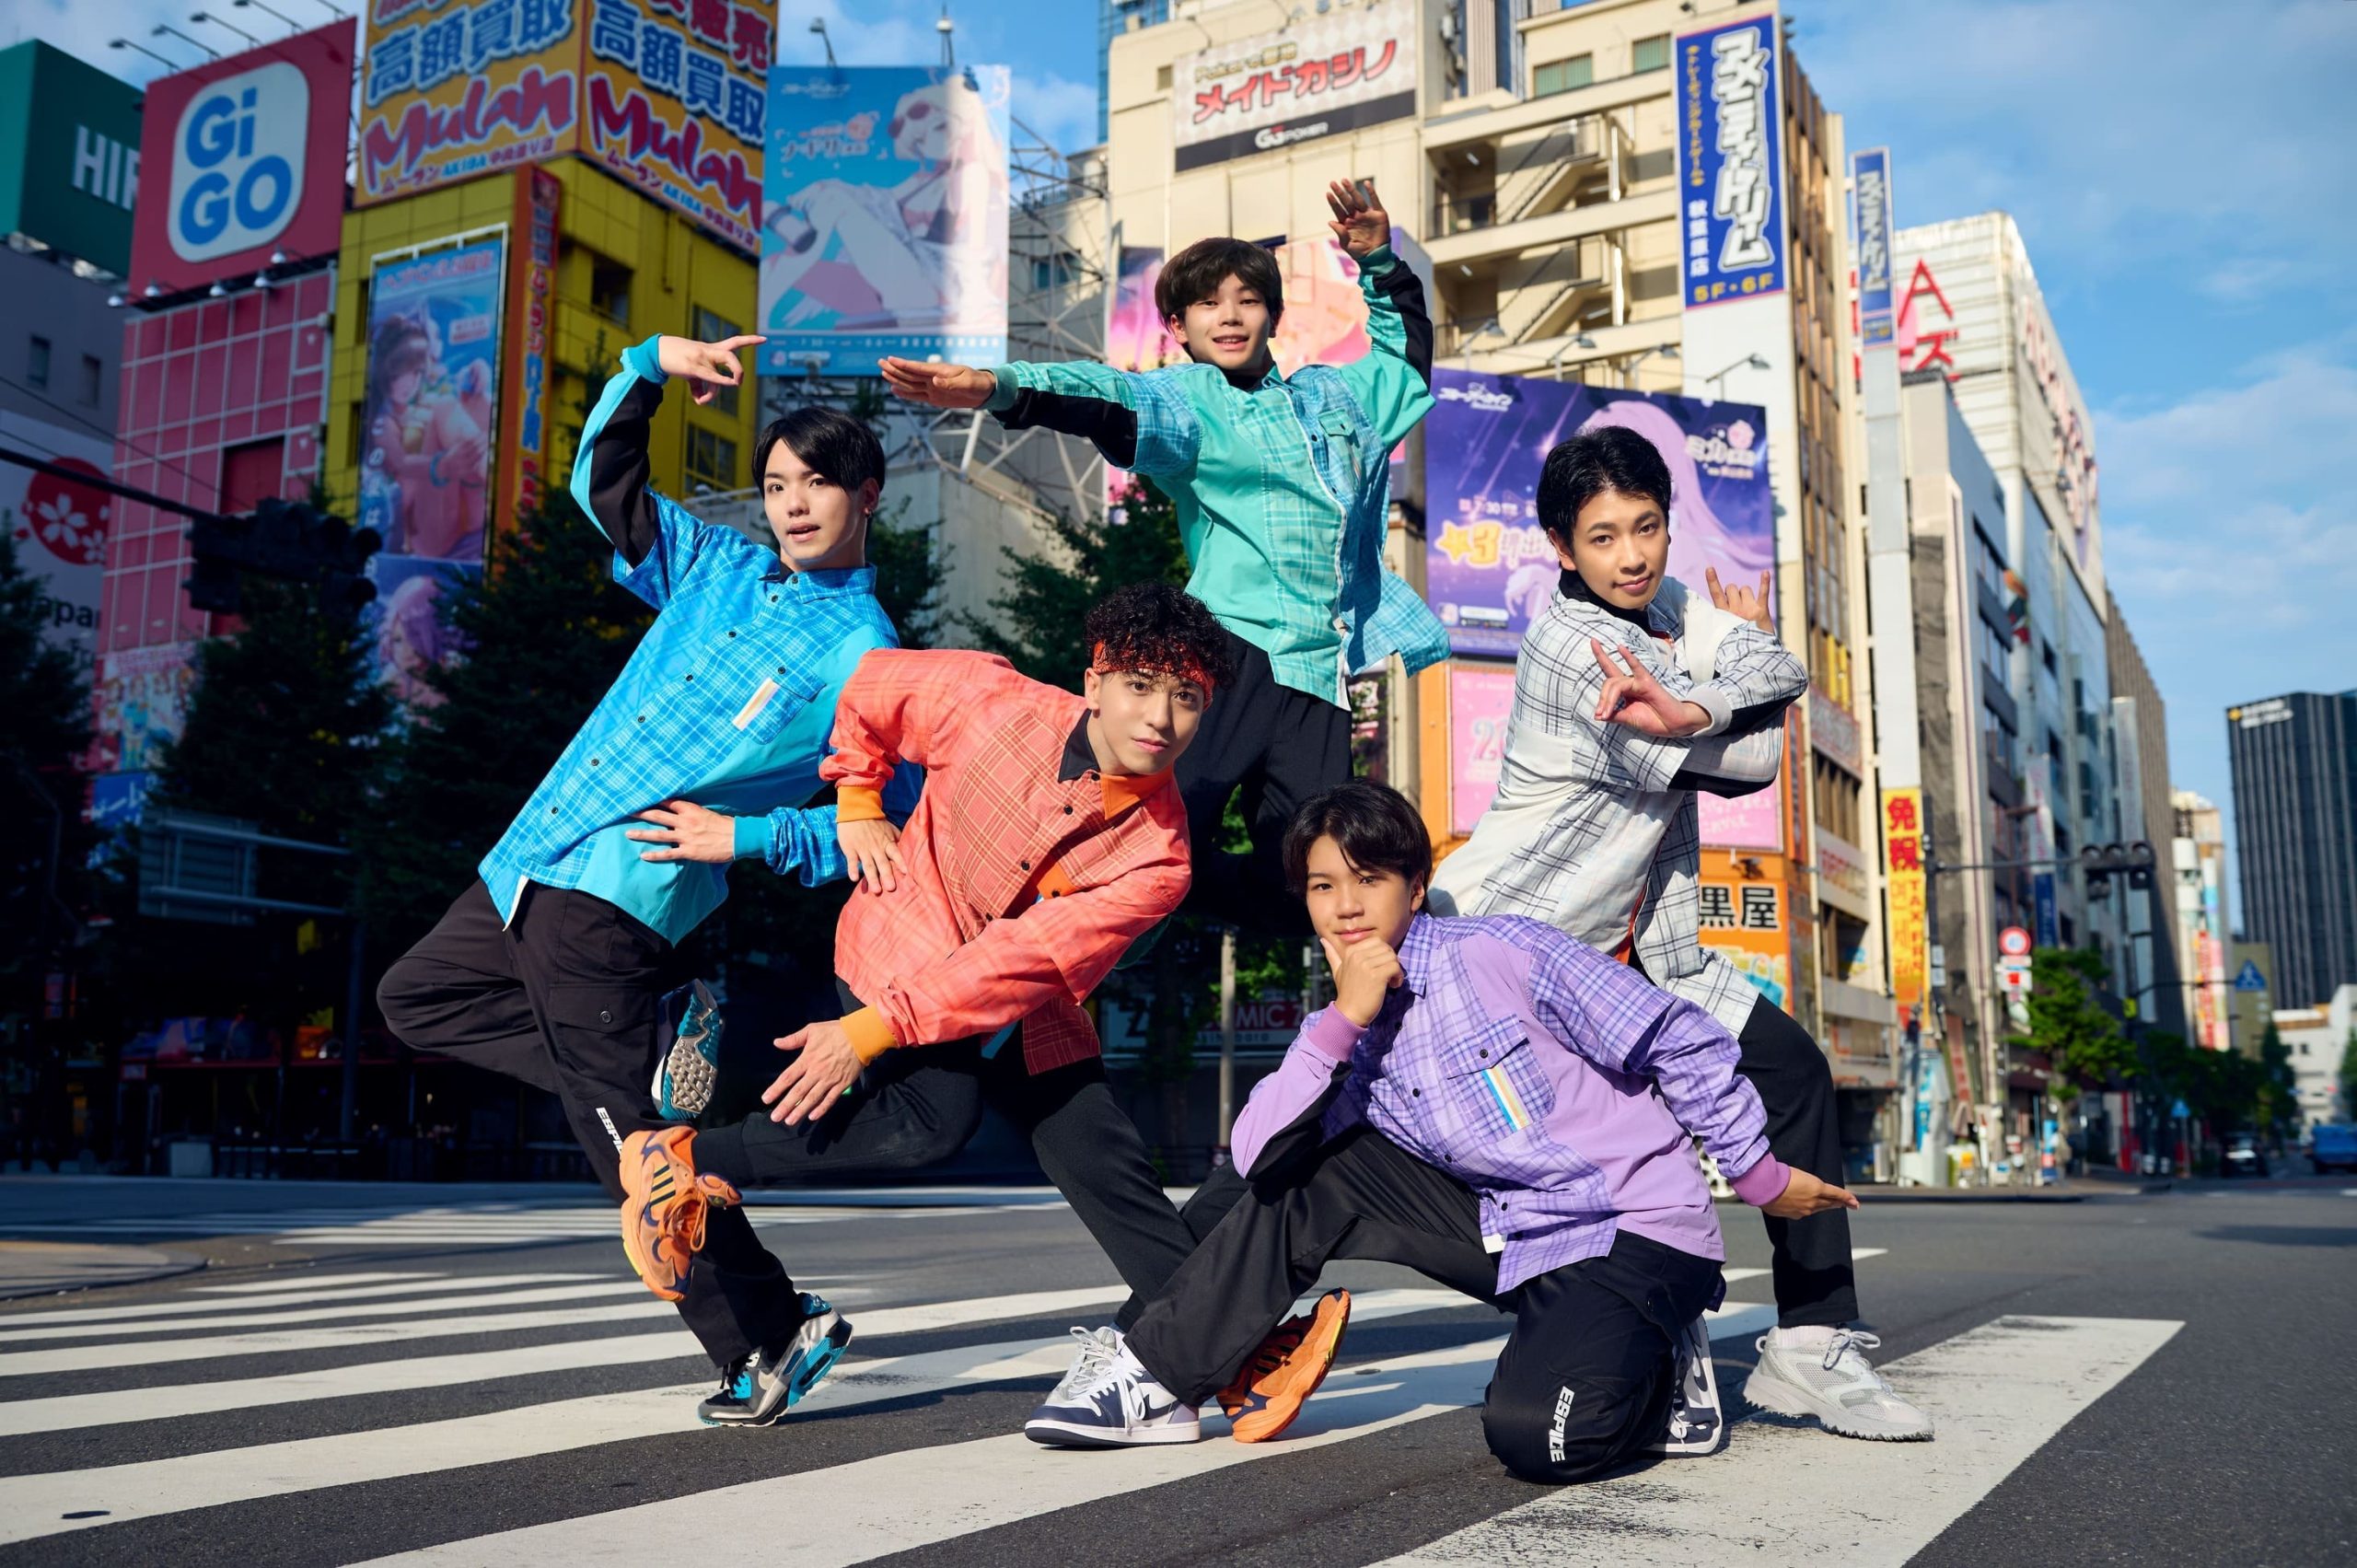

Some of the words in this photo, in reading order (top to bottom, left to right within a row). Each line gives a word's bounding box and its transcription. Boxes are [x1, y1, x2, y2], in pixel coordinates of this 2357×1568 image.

[366, 0, 574, 109] 高額買取
[591, 0, 766, 145] 高額買取
[1193, 39, 1398, 125] メイドカジノ
[363, 64, 576, 195] Mulan
[588, 73, 763, 235] Mulan
[1887, 797, 1919, 871] 免税
[1699, 885, 1779, 932] 黒屋
